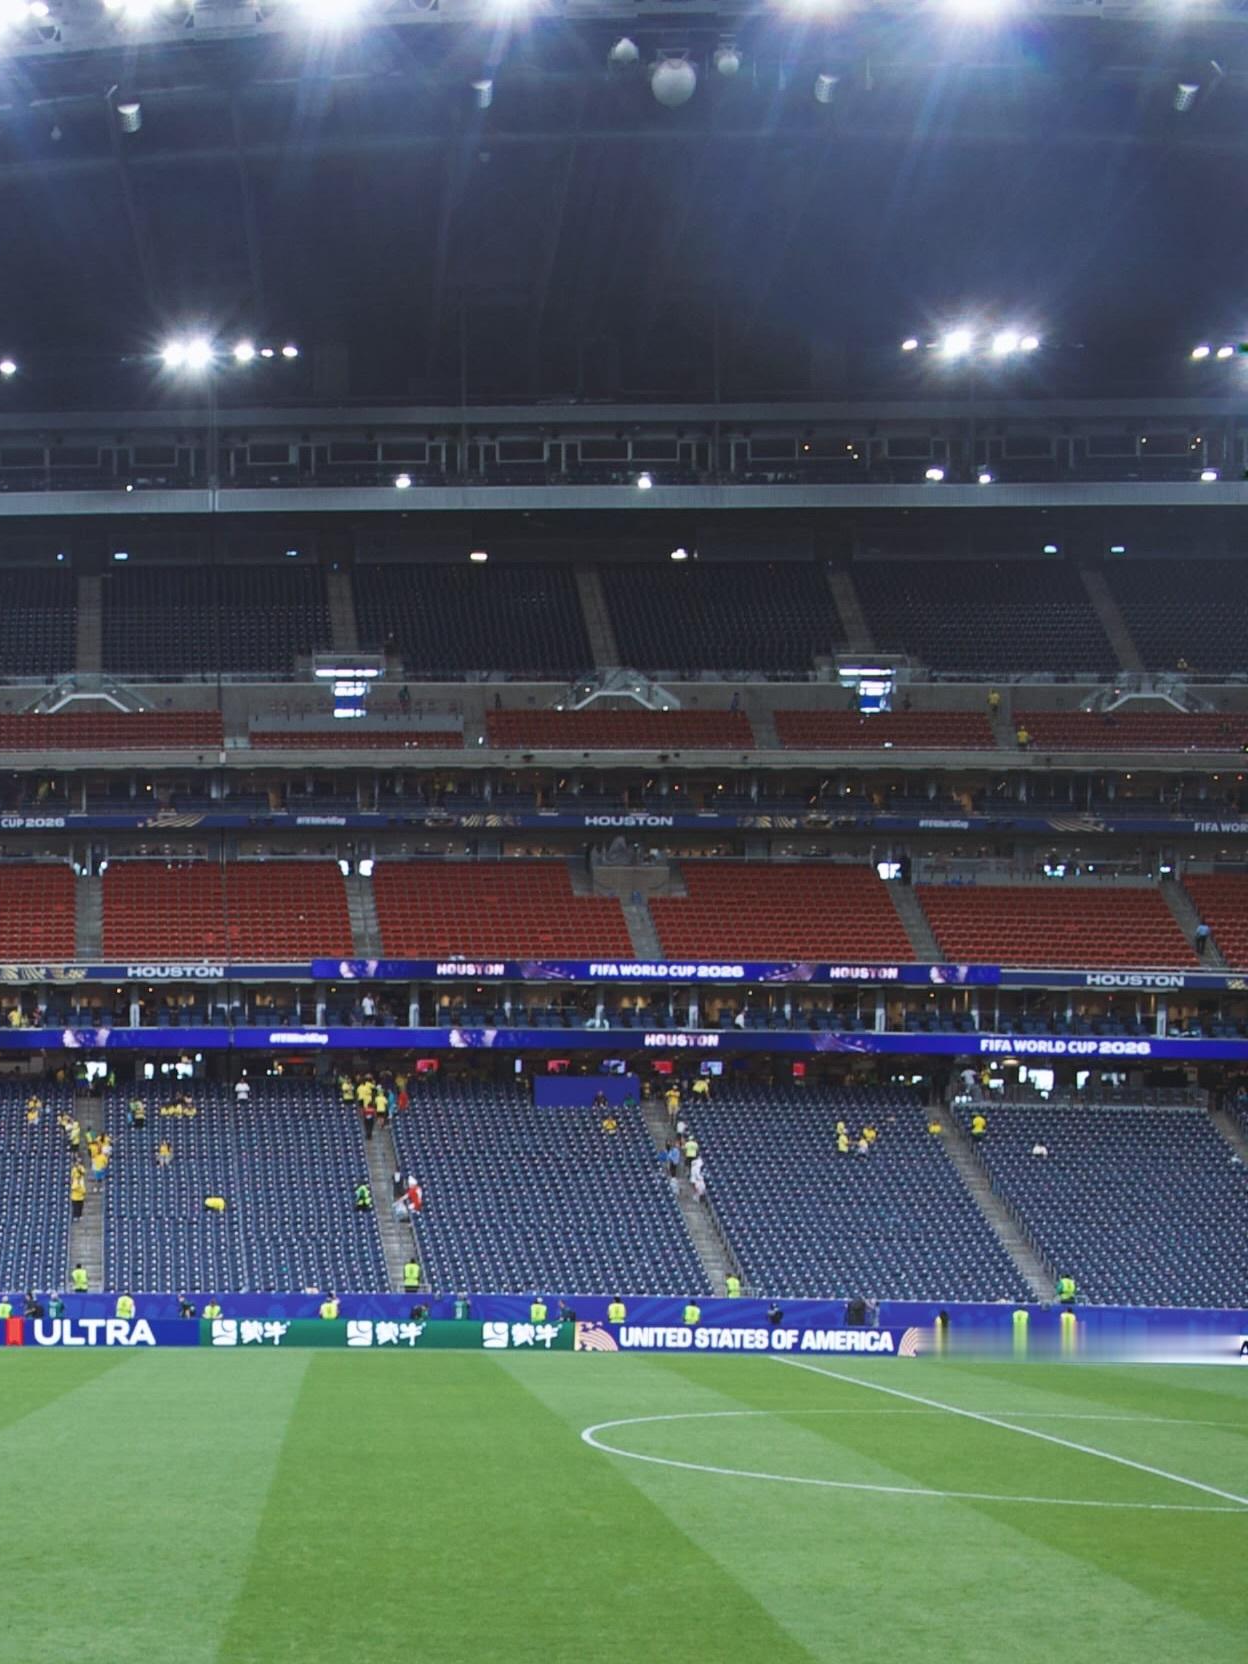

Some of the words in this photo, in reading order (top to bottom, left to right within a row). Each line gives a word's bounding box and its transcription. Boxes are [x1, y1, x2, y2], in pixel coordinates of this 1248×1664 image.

[1, 818, 25, 828] CUP
[25, 818, 65, 828] 2026
[585, 816, 673, 826] HOUSTON
[1194, 822, 1219, 832] FIFA
[126, 966, 225, 978] HOUSTON
[436, 963, 505, 976] HOUSTON
[589, 964, 618, 977] FIFA
[619, 964, 668, 977] WORLD
[669, 965, 697, 977] CUP
[697, 965, 744, 978] 2026
[830, 967, 899, 979] HOUSTON
[1086, 974, 1185, 987] HOUSTON
[644, 1034, 720, 1047] HOUSTON
[980, 1039, 1012, 1052] FIFA
[1013, 1040, 1067, 1053] WORLD
[1068, 1041, 1098, 1054] CUP
[1099, 1042, 1151, 1055] 2026
[34, 1318, 156, 1346] ULTRA
[619, 1326, 693, 1348] UNITED
[694, 1327, 769, 1350] STATES
[770, 1328, 799, 1350] OF
[800, 1330, 895, 1352] AMERICA
